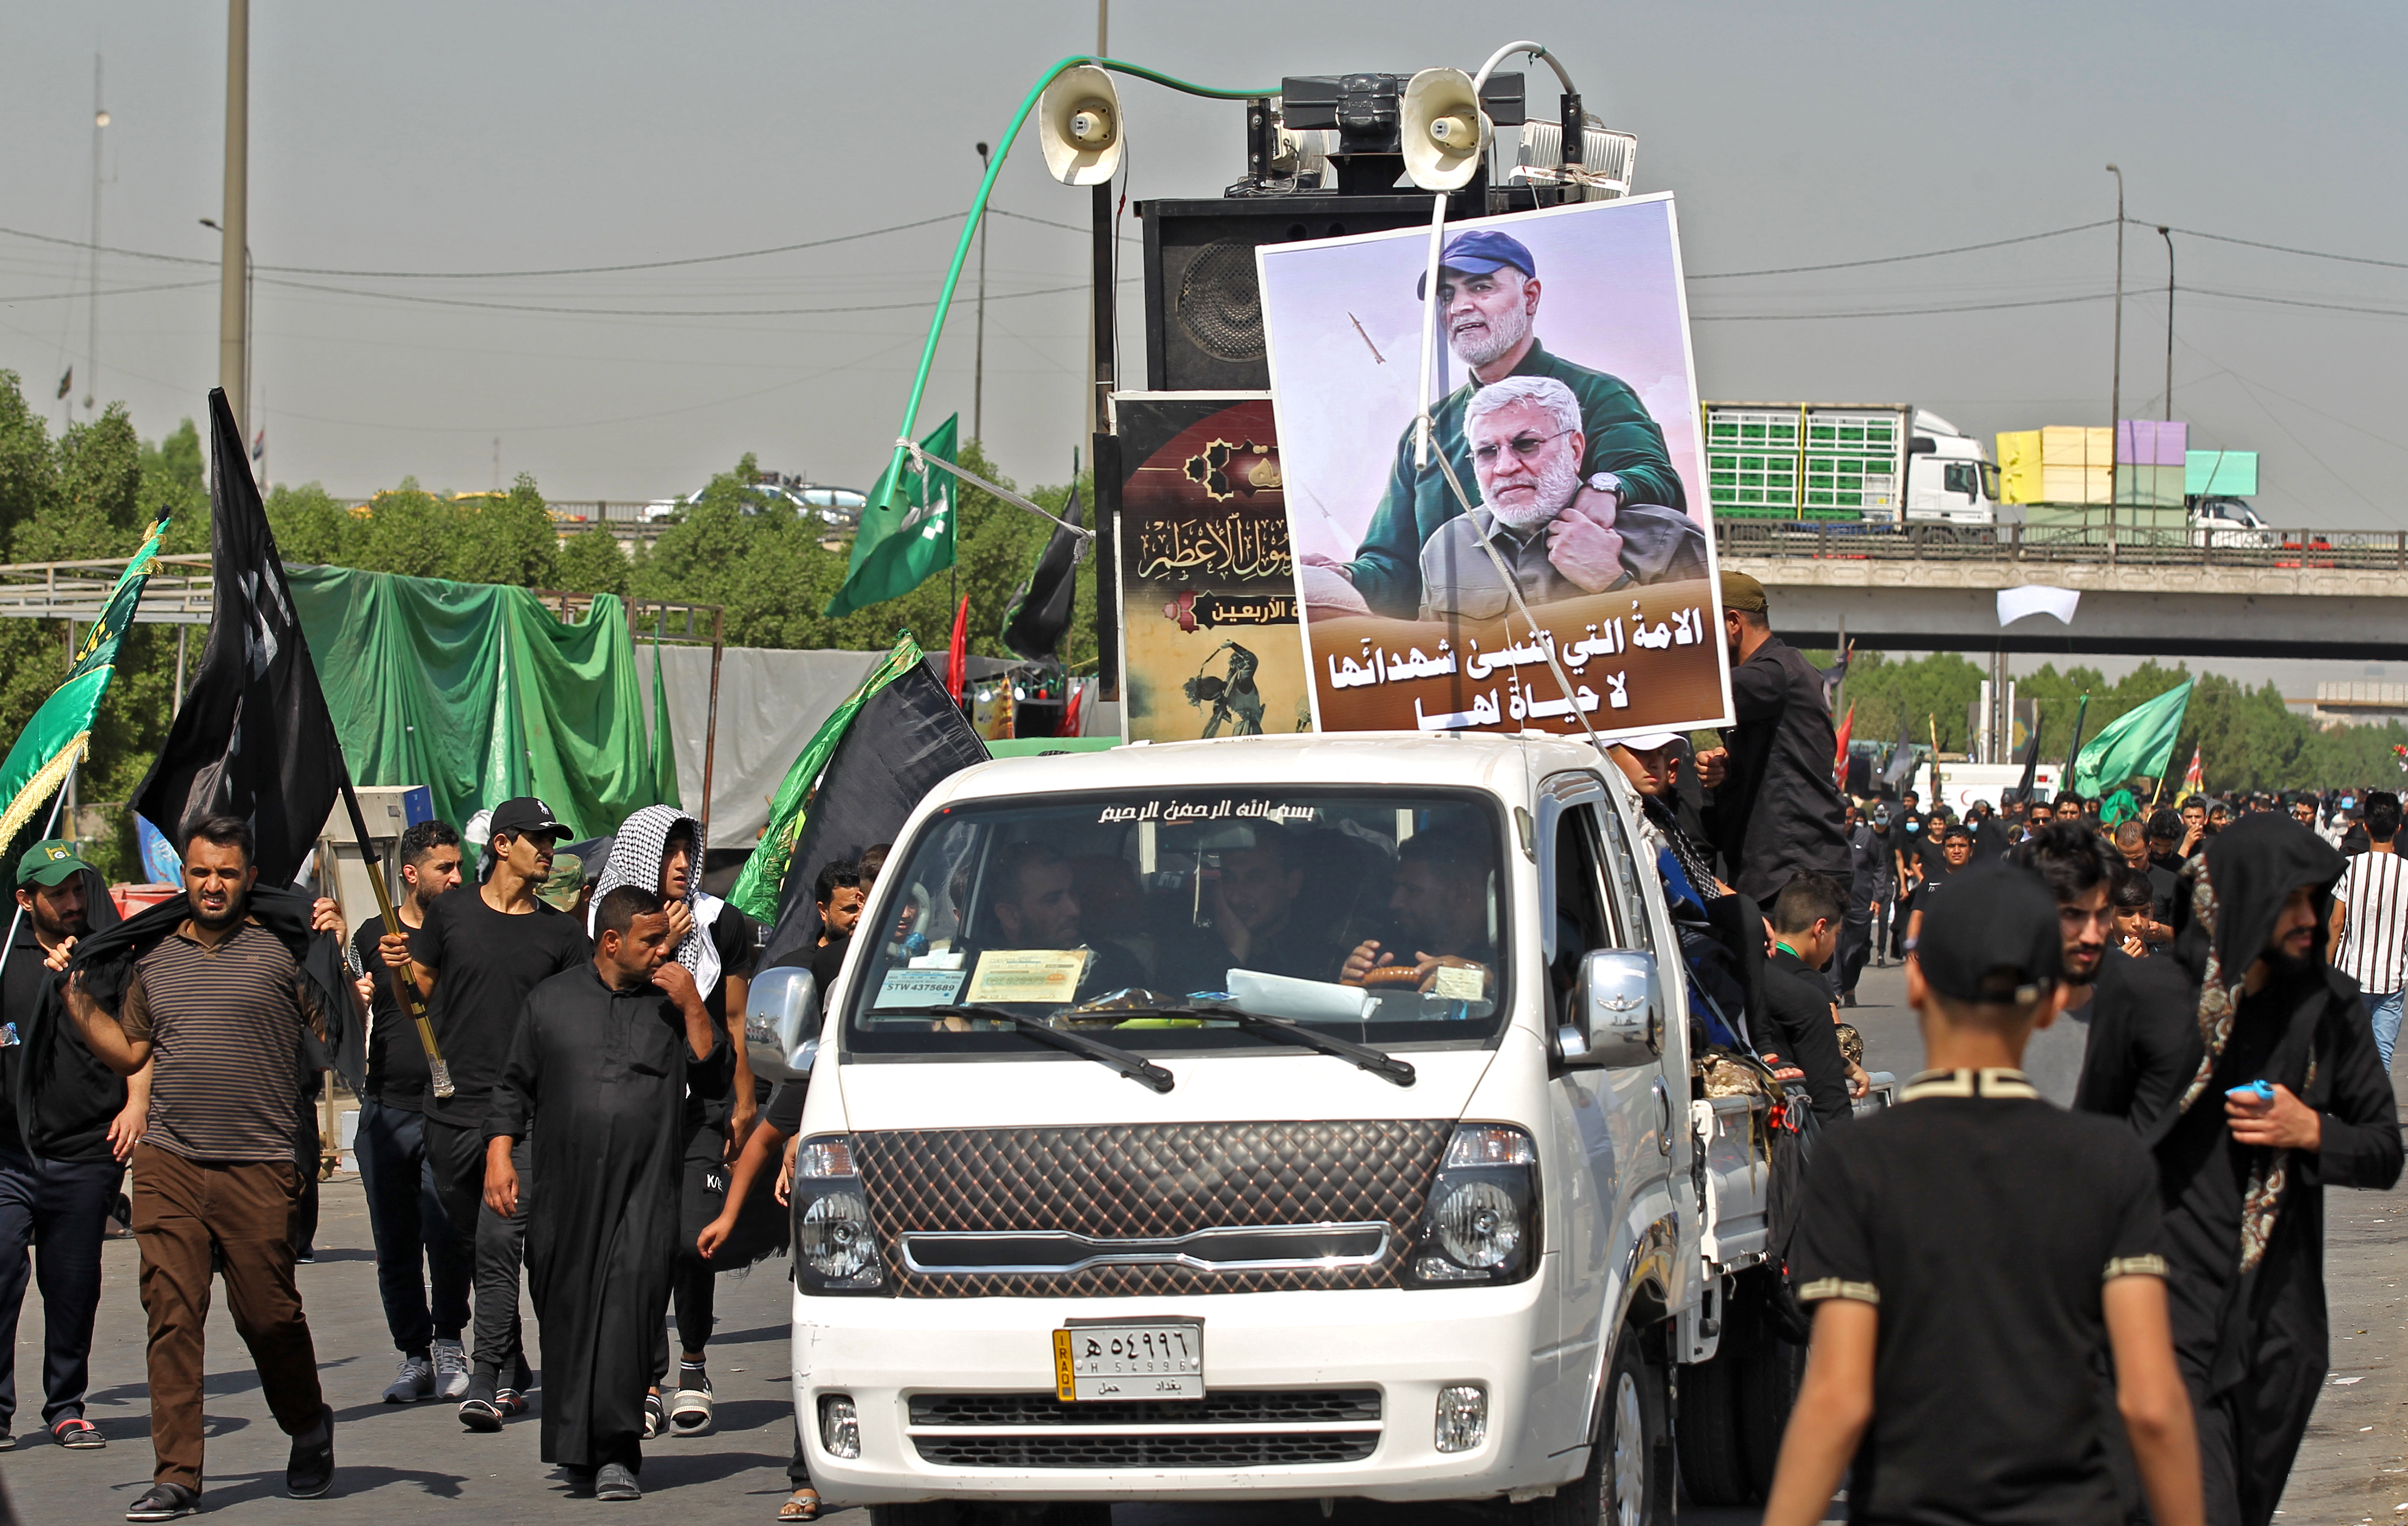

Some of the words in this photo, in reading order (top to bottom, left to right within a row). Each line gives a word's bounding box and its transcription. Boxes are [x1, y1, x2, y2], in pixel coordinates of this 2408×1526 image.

[1211, 596, 1286, 623] الأربعين
[1562, 616, 1625, 675] التي
[1606, 670, 1629, 709] لا
[1413, 688, 1501, 732] لها
[1098, 800, 1160, 823] الرحيم
[1163, 799, 1231, 820] الرحمن
[1235, 799, 1271, 820] الله
[1274, 803, 1315, 821] بسم
[887, 983, 910, 991] STW
[910, 983, 955, 992] 4375689
[1059, 1335, 1070, 1385] IRAQ
[1098, 1380, 1122, 1395] حمل
[1155, 1378, 1182, 1395] بغداد
